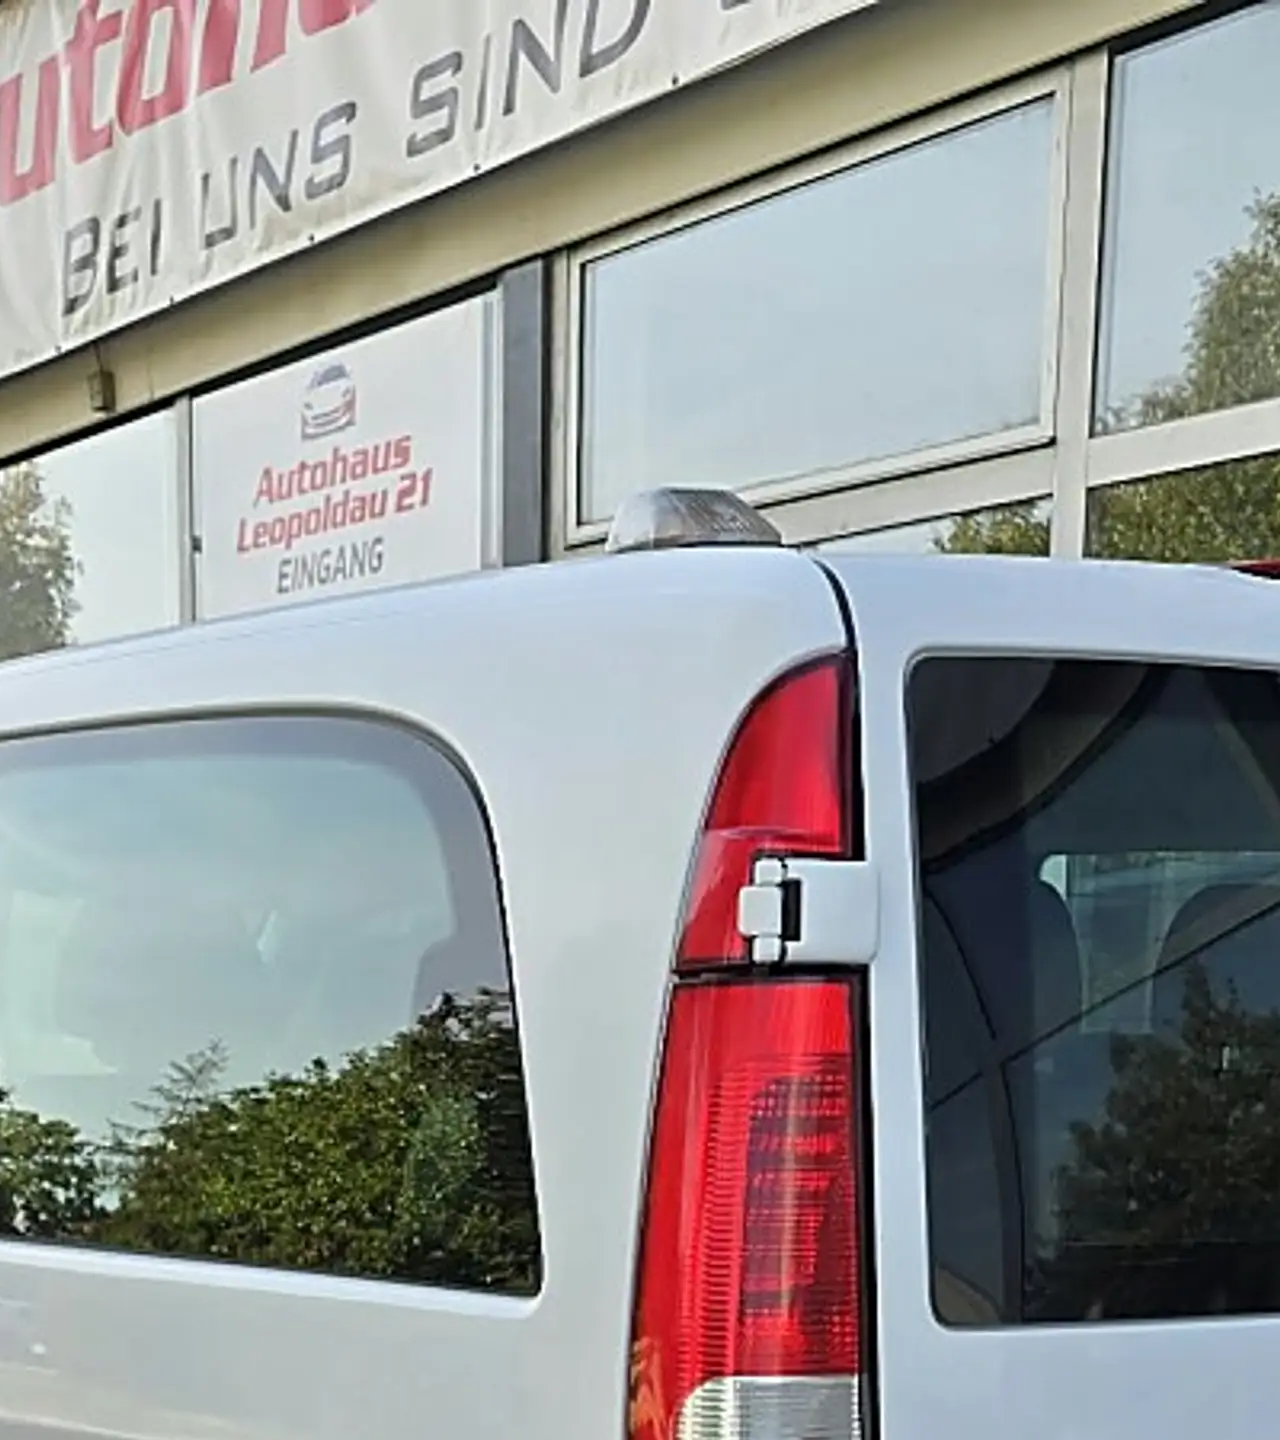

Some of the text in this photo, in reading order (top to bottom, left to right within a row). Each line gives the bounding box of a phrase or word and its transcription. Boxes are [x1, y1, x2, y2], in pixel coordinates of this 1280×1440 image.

[61, 0, 652, 317] BEI UNS SIND
[236, 467, 433, 553] Leopoldau 21
[253, 435, 412, 508] Autohaus
[276, 536, 384, 594] EINGANG
